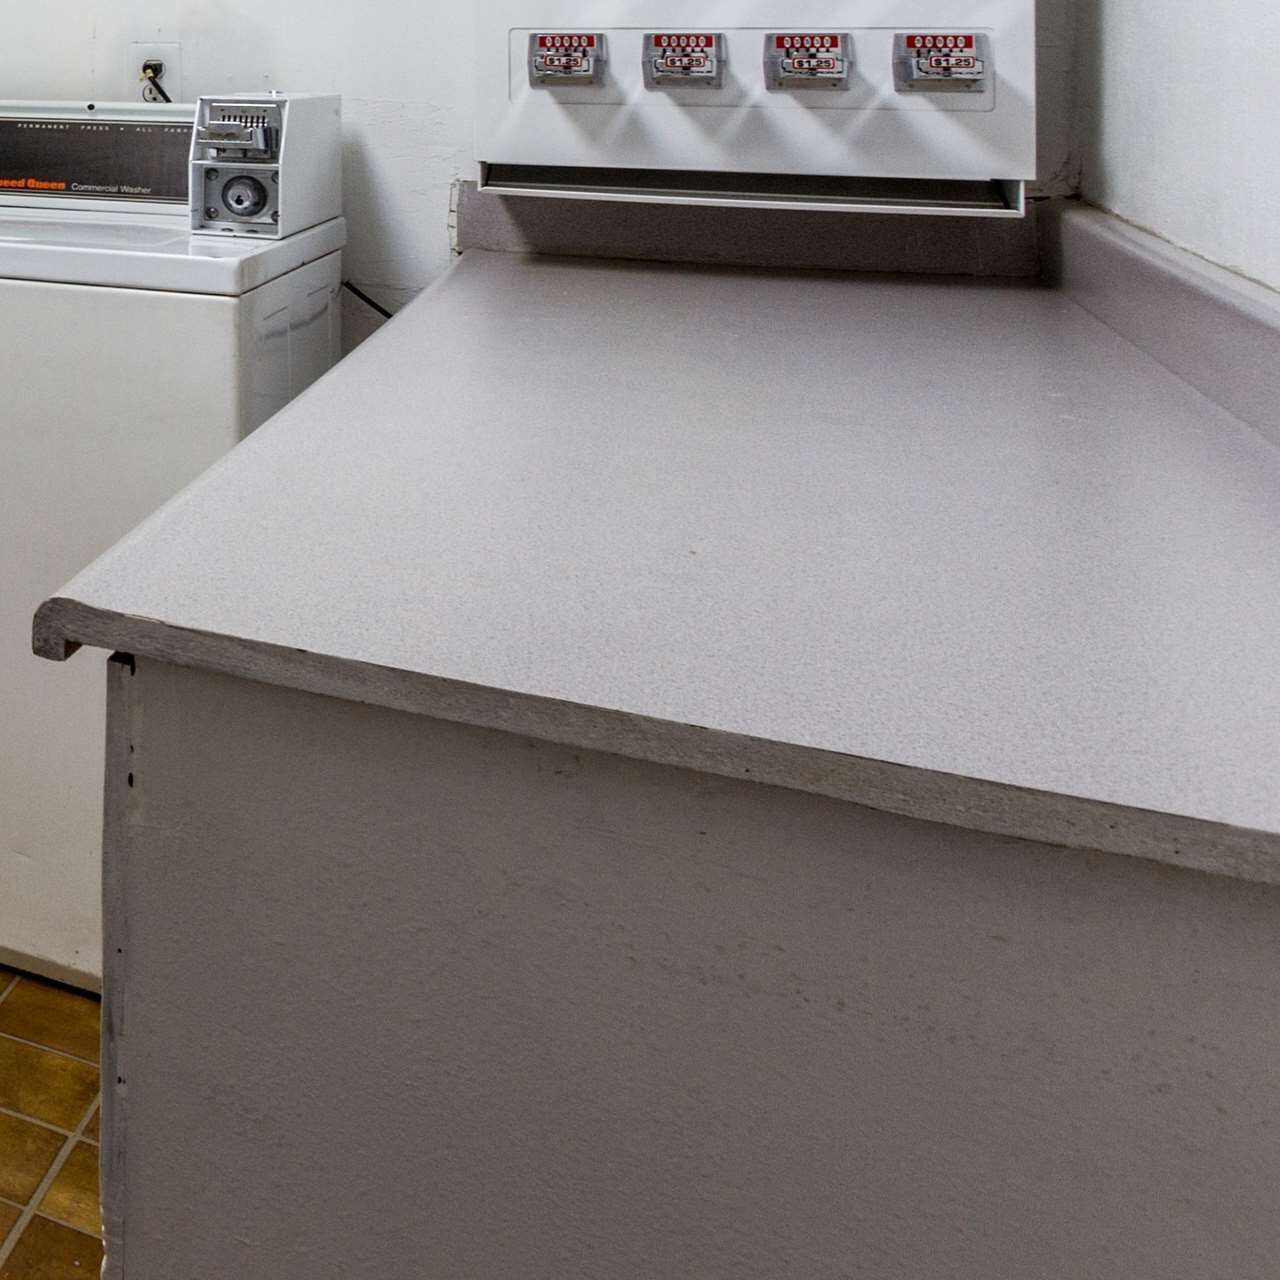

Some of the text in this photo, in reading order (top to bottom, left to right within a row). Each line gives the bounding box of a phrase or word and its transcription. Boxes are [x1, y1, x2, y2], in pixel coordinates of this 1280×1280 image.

[548, 58, 580, 66] $1.25
[669, 58, 703, 67] $1.25
[796, 59, 832, 68] $1.25
[933, 57, 971, 67] $1.25
[26, 178, 65, 190] Queen
[71, 182, 119, 193] Commercial
[120, 185, 152, 194] Washer
